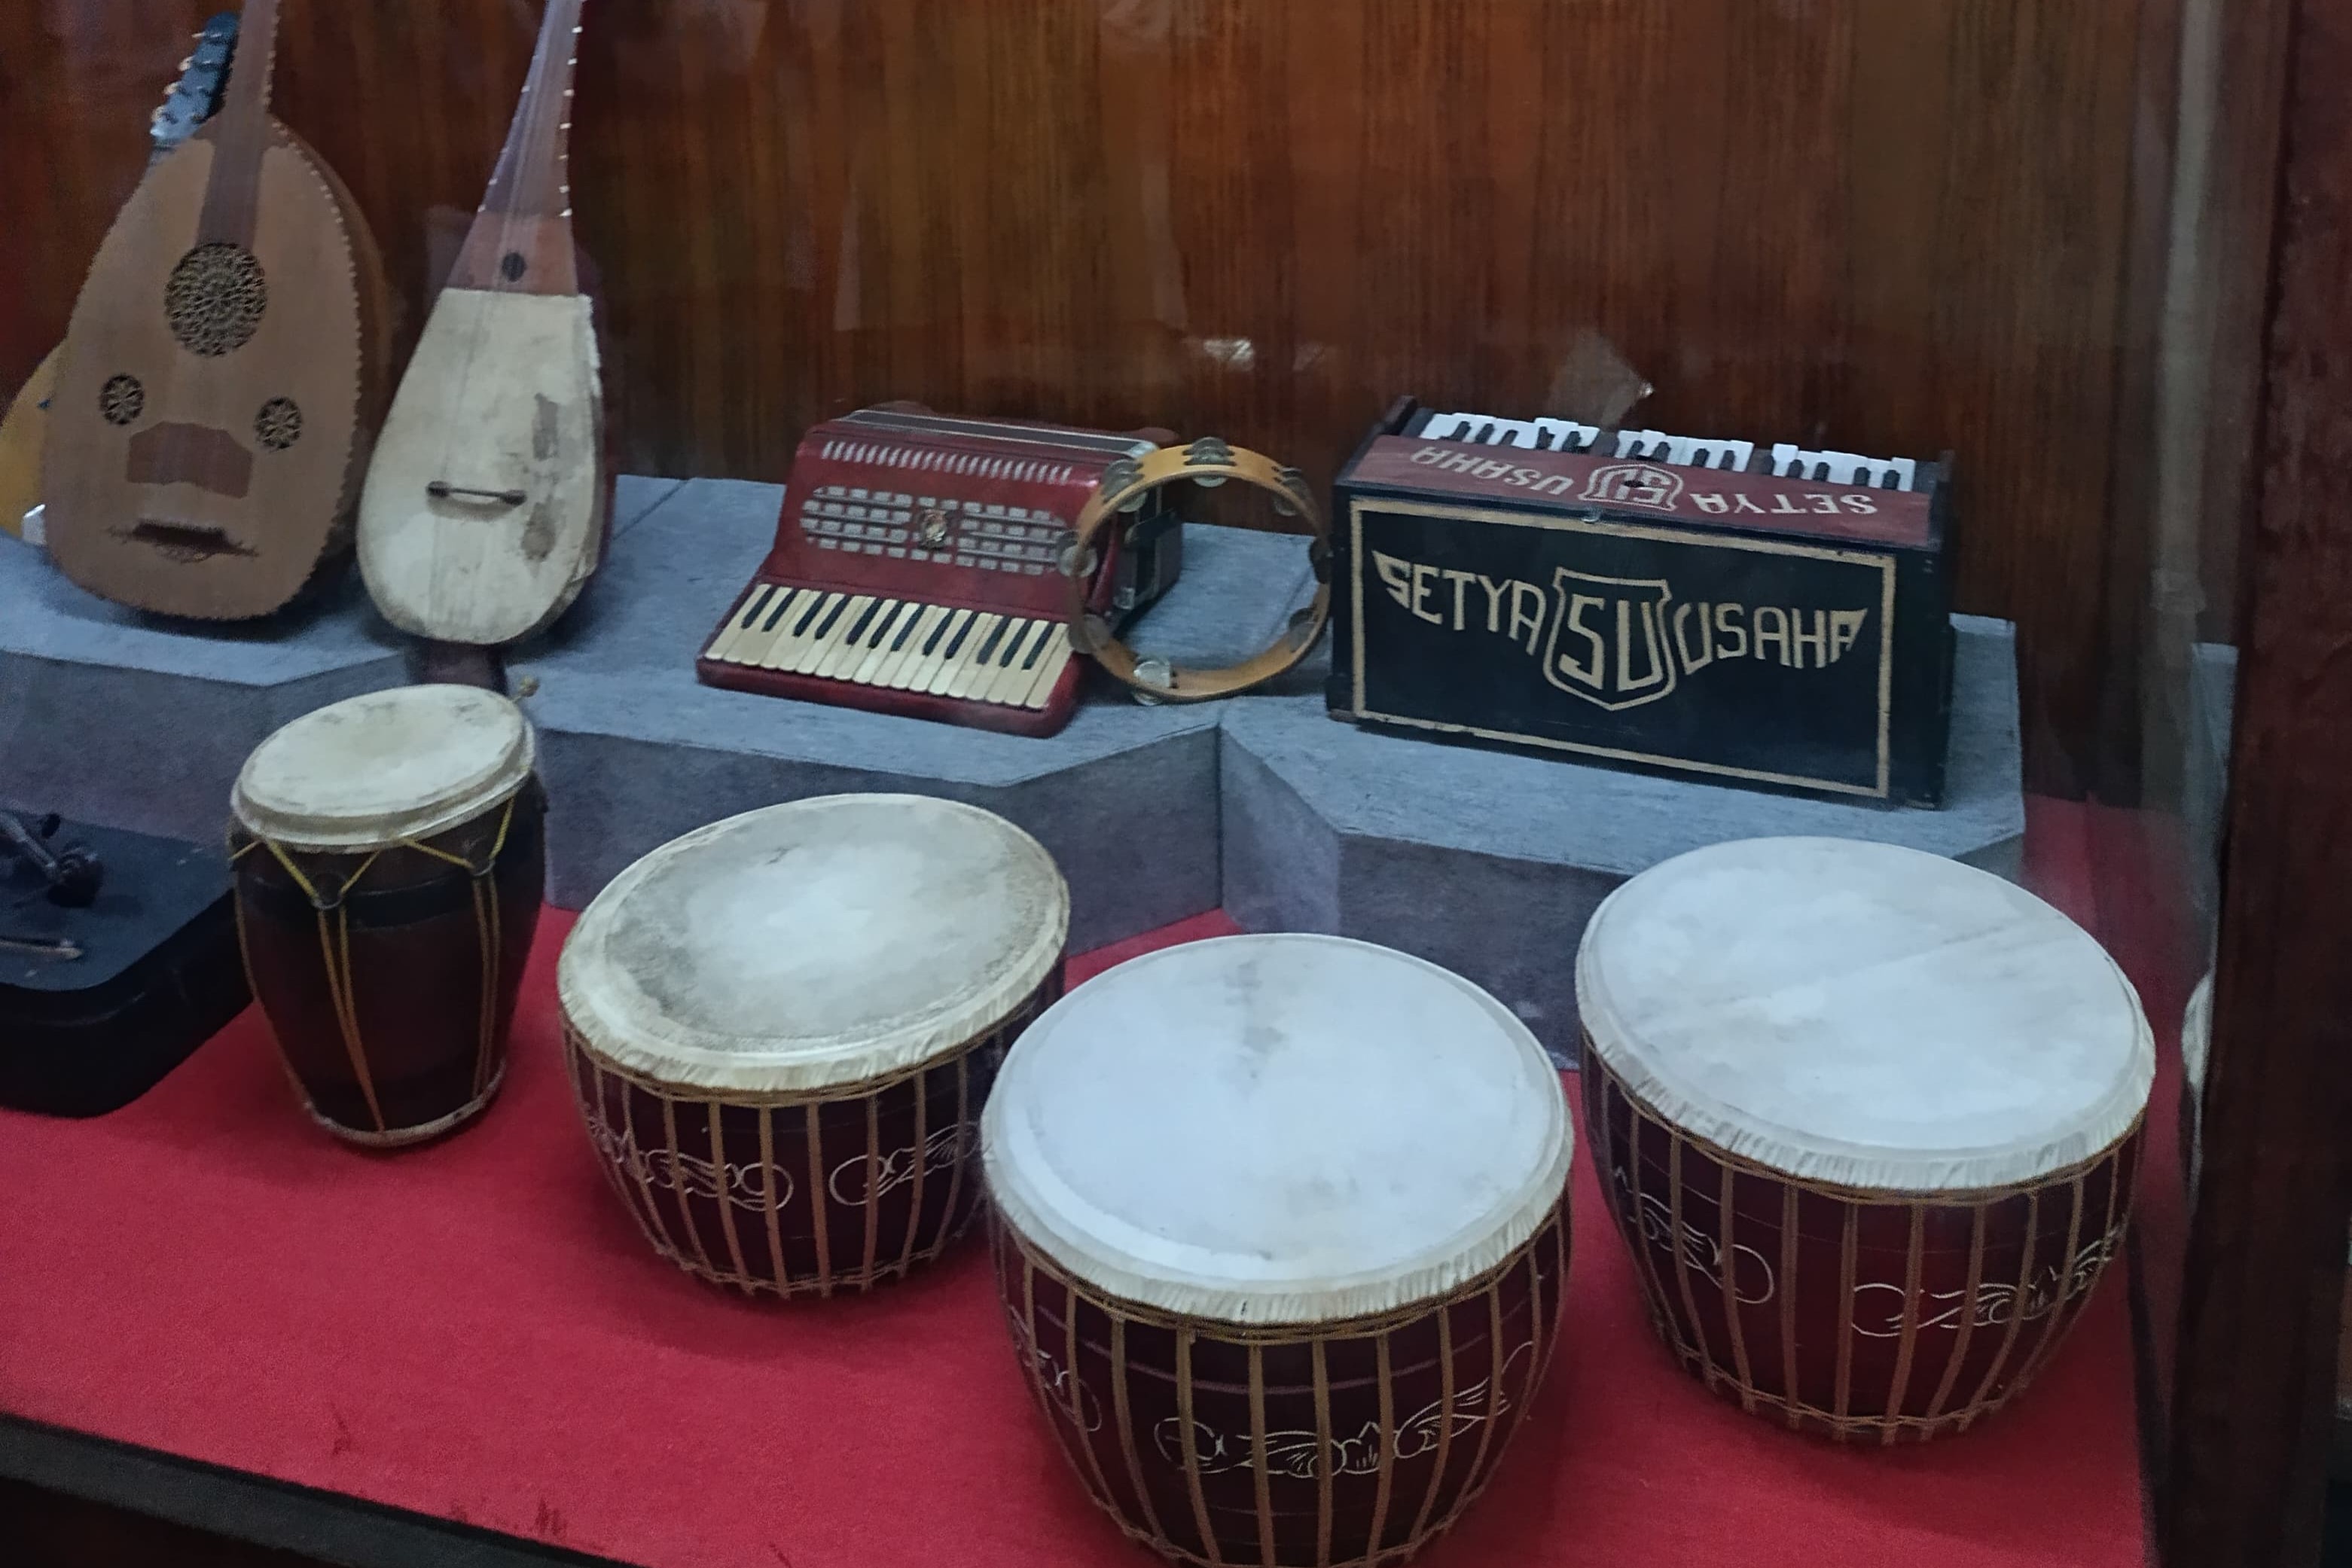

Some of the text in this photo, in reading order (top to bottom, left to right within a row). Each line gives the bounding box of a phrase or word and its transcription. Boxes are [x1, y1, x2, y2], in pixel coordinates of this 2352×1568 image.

[1411, 446, 1575, 495] USAHA
[1690, 493, 1878, 514] SETYA
[1372, 551, 1868, 691] SETYA SU USAHA
